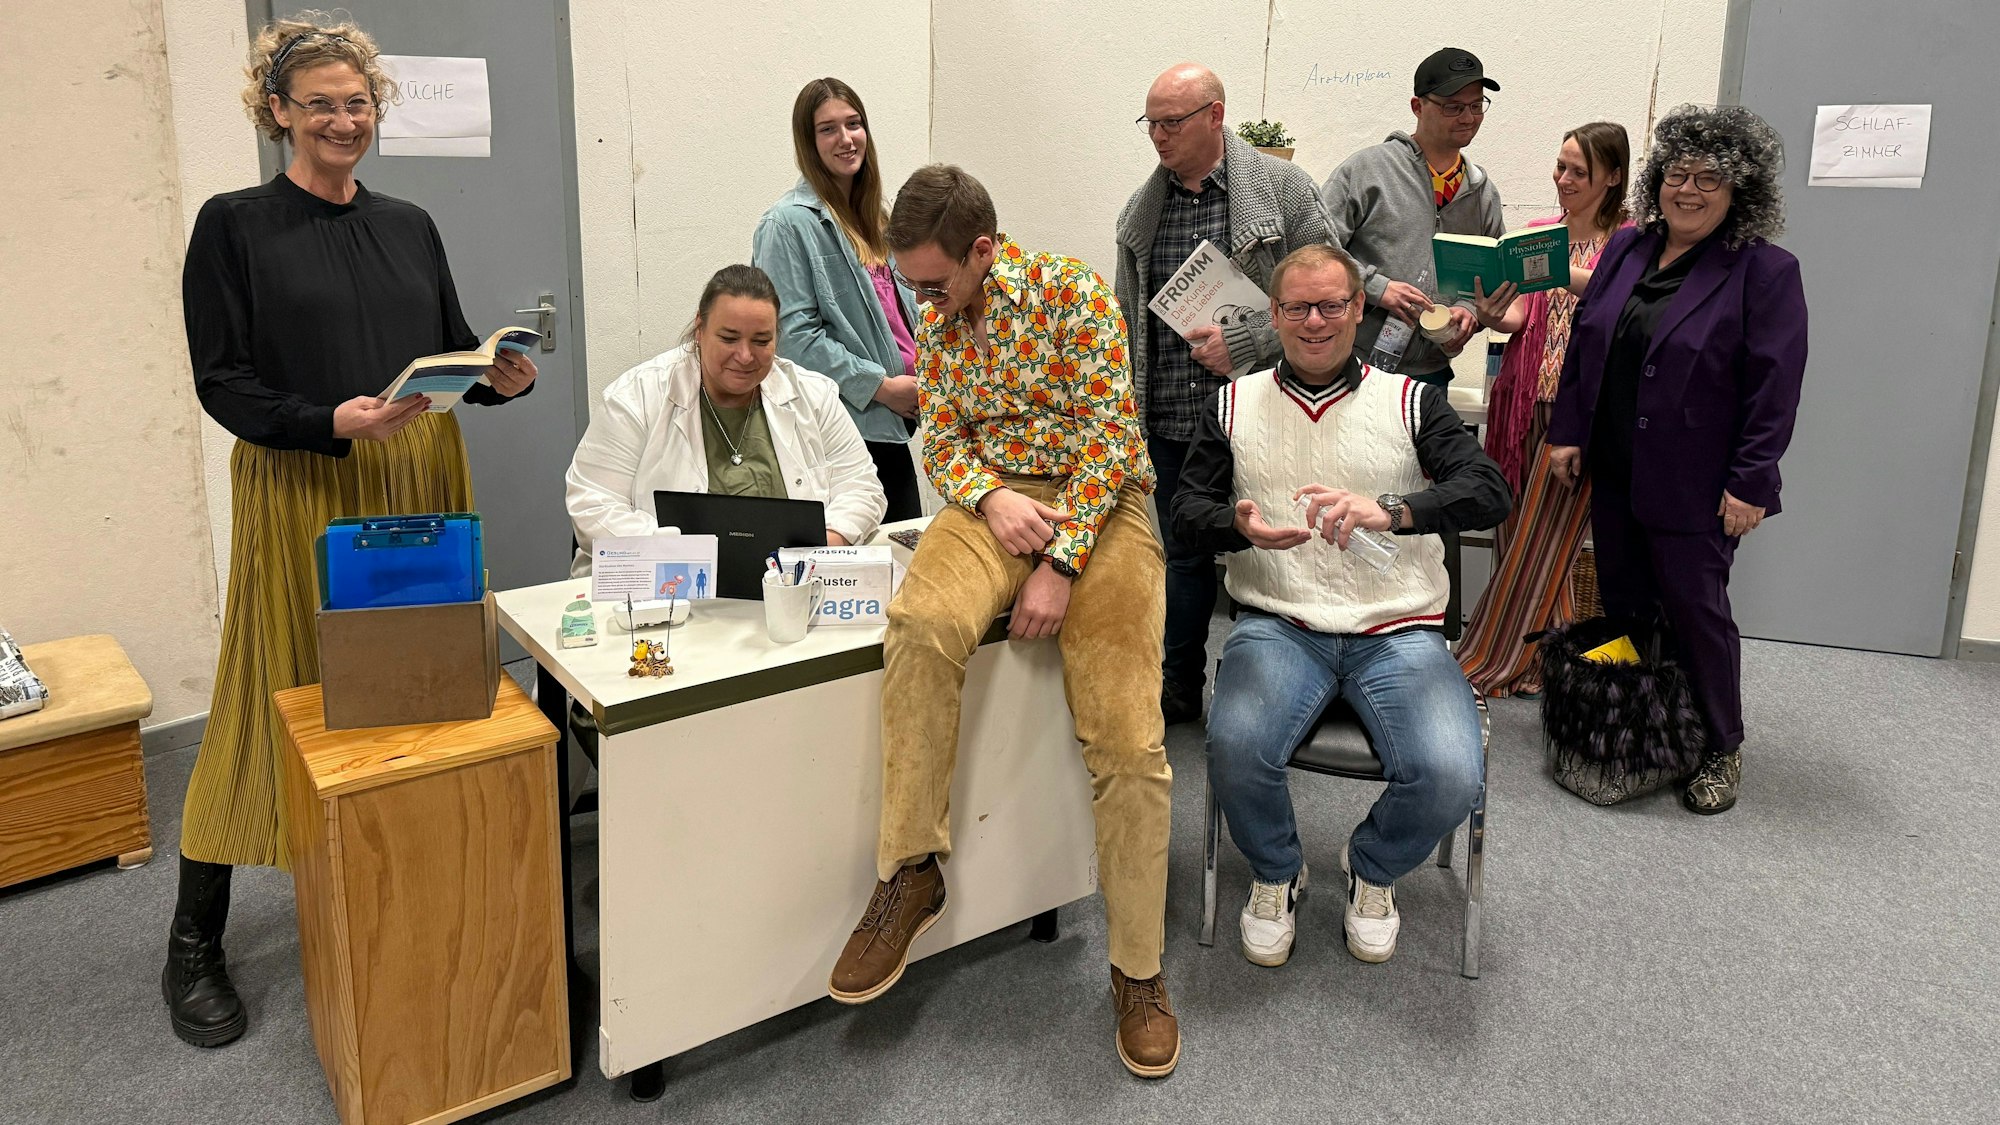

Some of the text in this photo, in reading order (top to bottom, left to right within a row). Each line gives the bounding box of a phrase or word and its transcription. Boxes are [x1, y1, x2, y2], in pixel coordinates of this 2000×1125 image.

[396, 80, 455, 101] KÜCHE
[1833, 115, 1913, 131] SCHLAF-
[1842, 144, 1903, 158] ZIMMER
[1509, 239, 1561, 255] Physiologie
[1157, 251, 1214, 312] FROMM
[1170, 280, 1208, 320] Die Kunst
[1180, 279, 1224, 328] des Liebens
